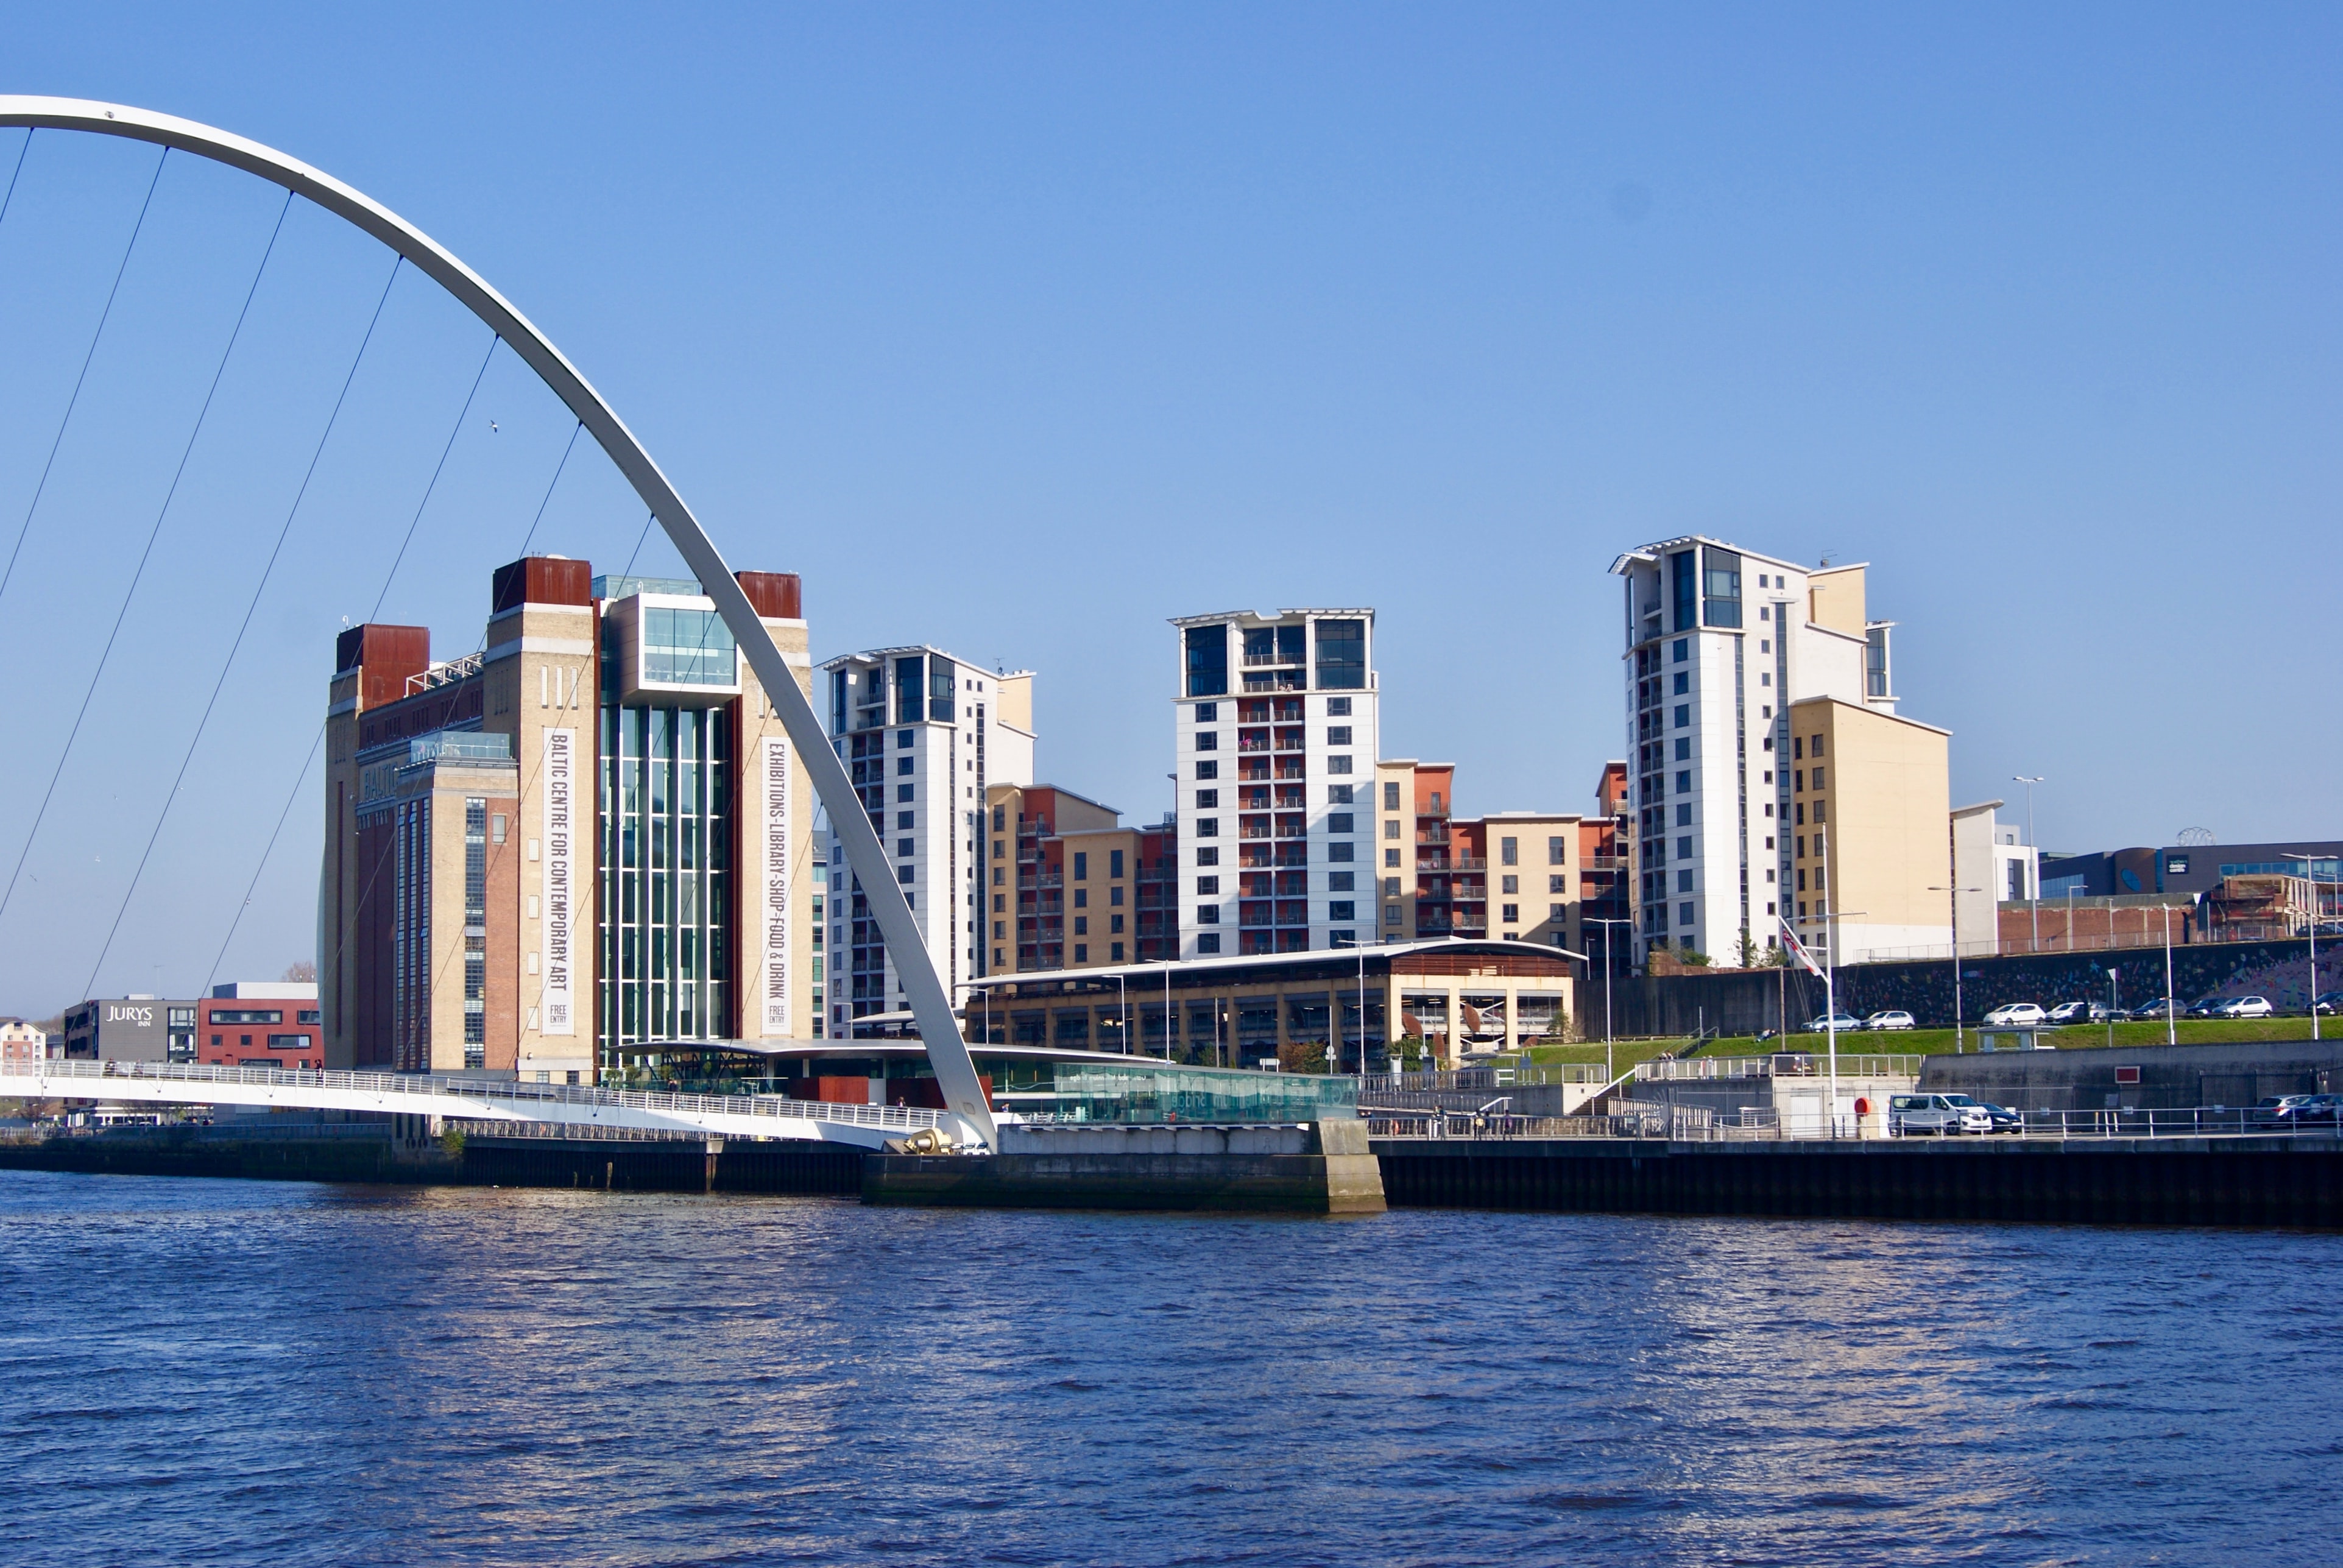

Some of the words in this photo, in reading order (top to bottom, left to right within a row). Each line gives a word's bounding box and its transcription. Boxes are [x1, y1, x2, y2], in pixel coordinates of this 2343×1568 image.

[551, 735, 568, 777] BALTIC
[551, 782, 568, 828] CENTRE
[551, 832, 567, 856] FOR
[550, 860, 567, 962] CONTEMPORARY
[550, 966, 567, 991] ART
[769, 962, 785, 999] DRINK
[106, 1006, 152, 1022] JURYS
[550, 1005, 567, 1015] FREE
[769, 1005, 785, 1015] FREE
